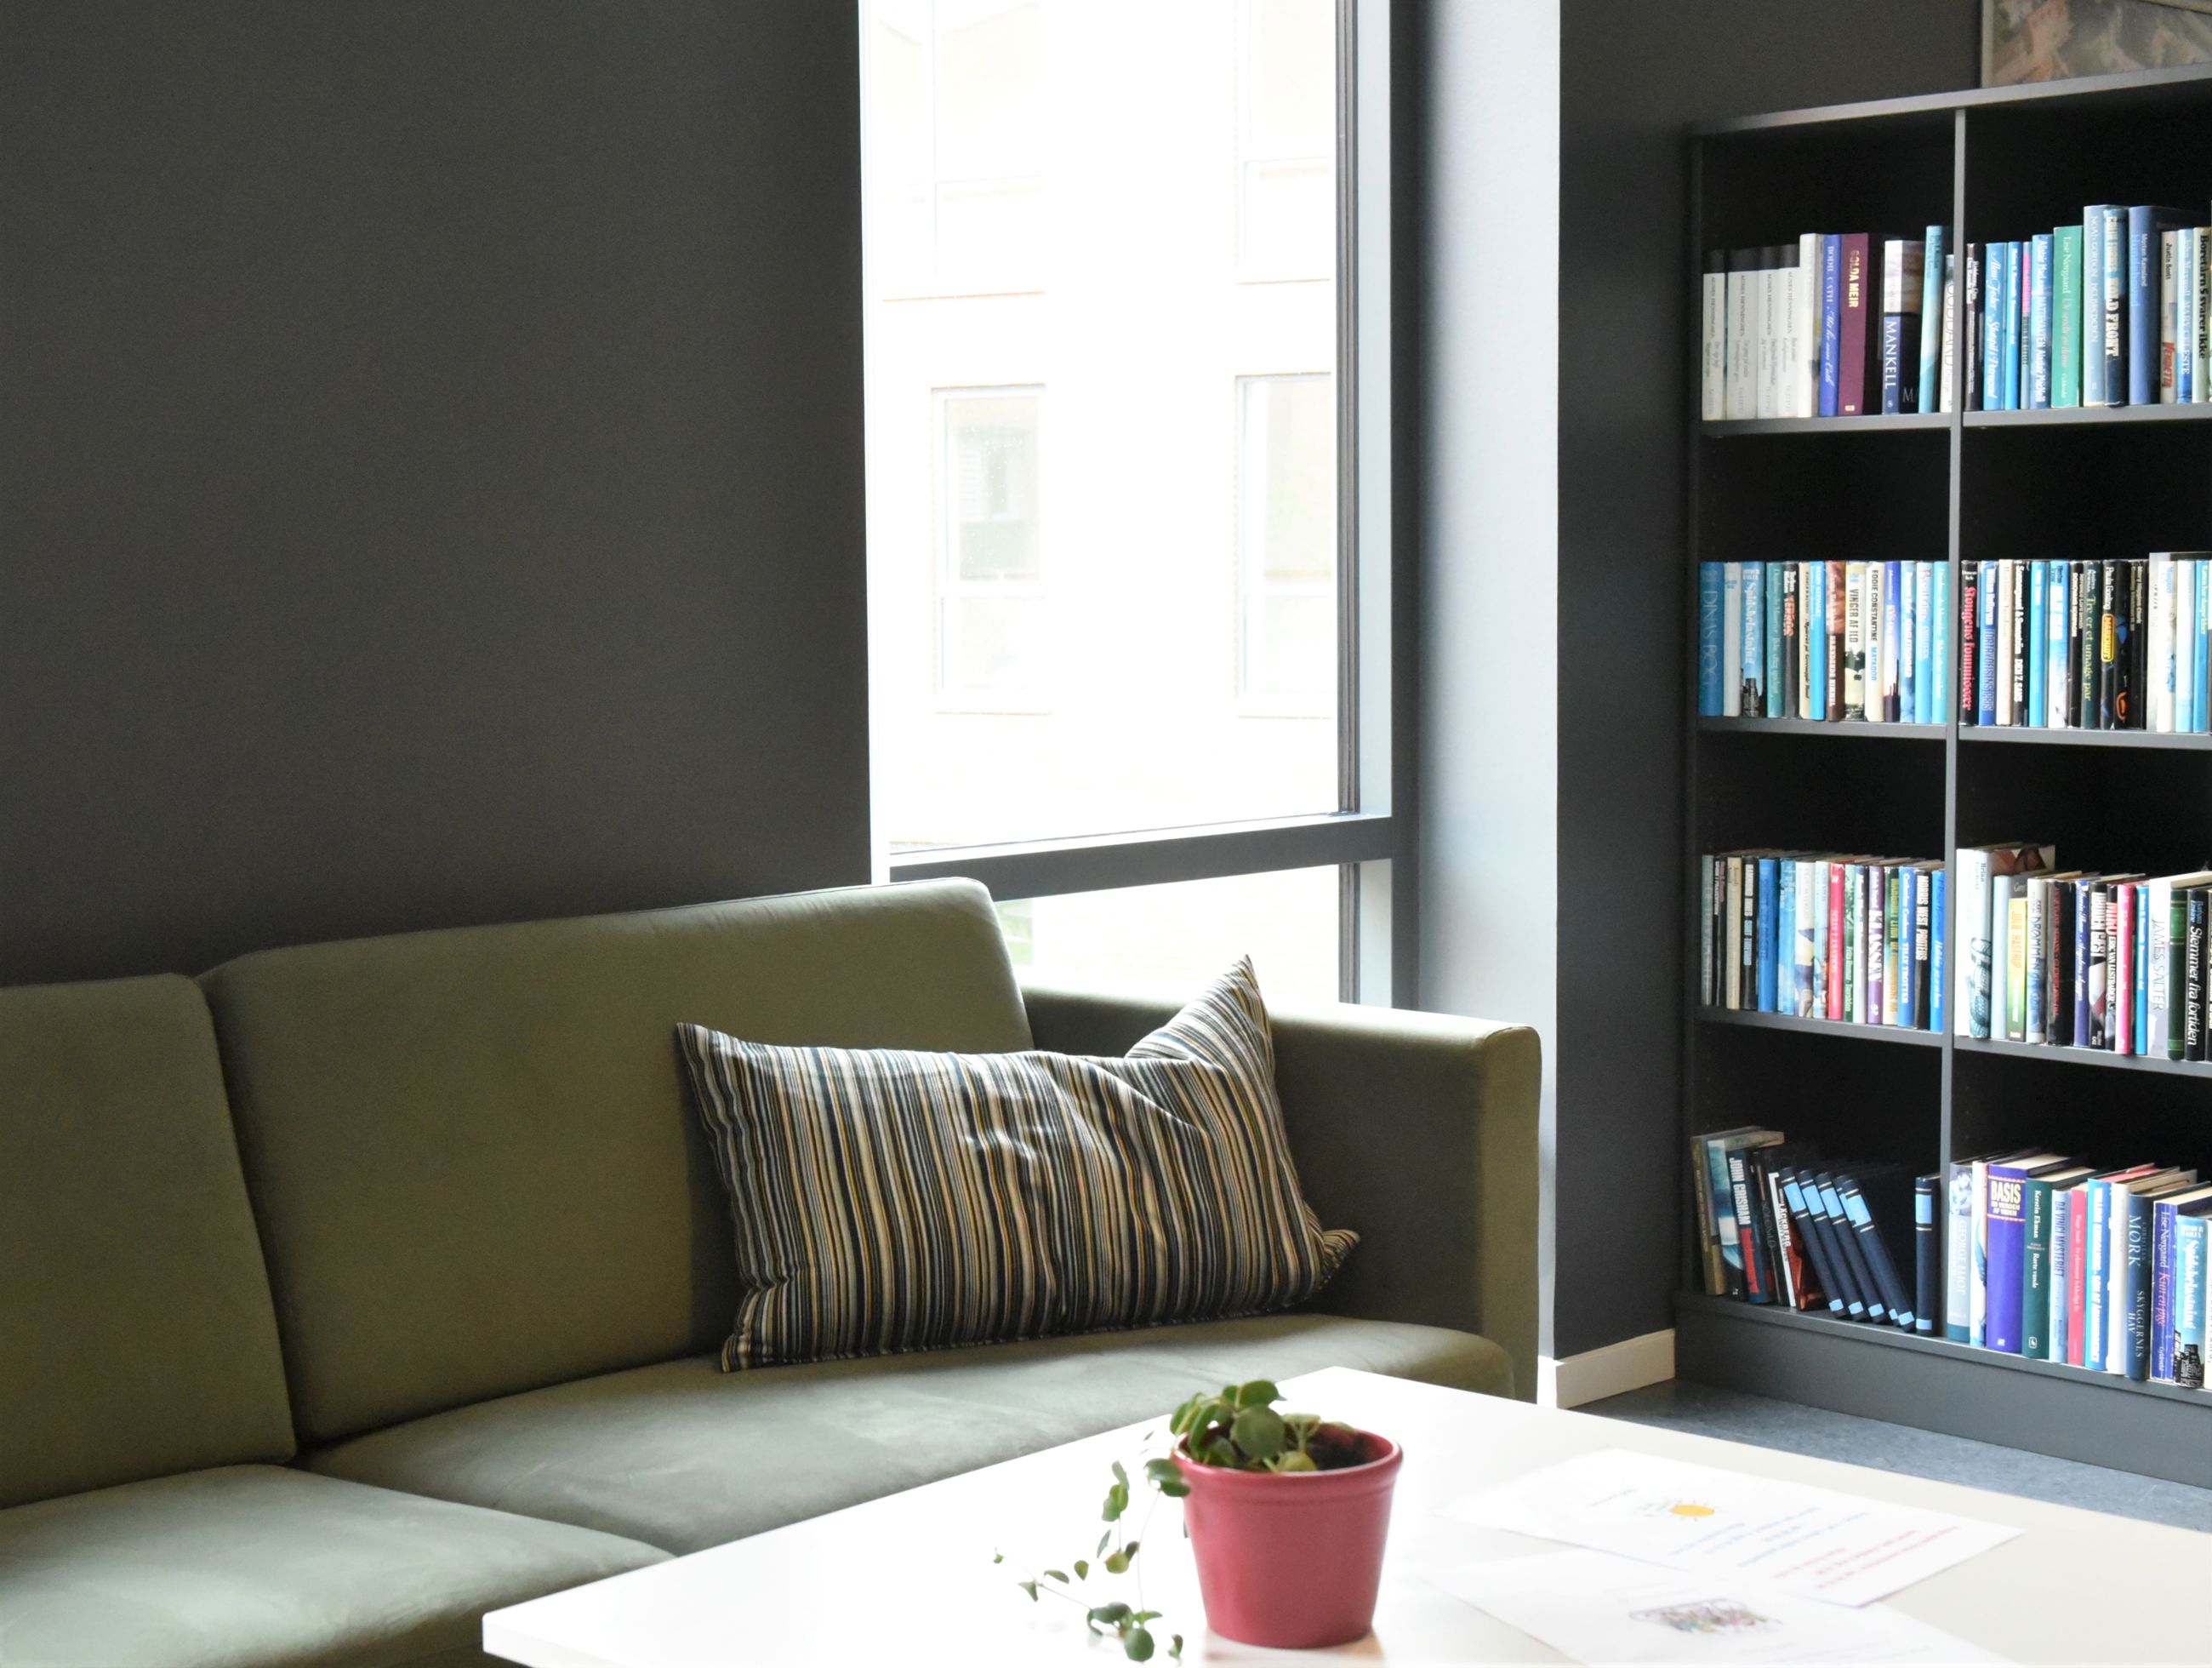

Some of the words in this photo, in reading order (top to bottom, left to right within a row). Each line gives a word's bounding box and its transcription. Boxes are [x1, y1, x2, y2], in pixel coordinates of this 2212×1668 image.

[2062, 237, 2072, 253] Lise
[1849, 250, 1860, 282] GOLDA
[2060, 253, 2071, 294] Nørgaard
[2198, 235, 2209, 287] Boretårn
[1849, 283, 1859, 308] MEIR
[2198, 296, 2206, 332] svarer
[2106, 313, 2118, 357] FRONT
[2198, 334, 2208, 359] ikke
[1885, 321, 1897, 390] MANKELL
[2105, 566, 2114, 586] Paula
[1849, 589, 1859, 618] VINGER
[1962, 586, 1976, 640] Kongens
[2086, 596, 2096, 614] Tre
[2103, 586, 2113, 610] Gosling
[1702, 590, 1718, 639] DINAS
[1849, 620, 1858, 629] AF
[2086, 617, 2094, 629] er
[1849, 630, 1858, 643] ILD
[2086, 631, 2094, 641] et
[1702, 645, 1718, 686] BOG
[2083, 644, 2093, 680] umage
[2083, 683, 2092, 702] par
[1916, 875, 1929, 905] MORRIS
[1916, 905, 1929, 926] WEST
[2090, 892, 2106, 929] UBUDEN
[2106, 902, 2118, 935] MIKO
[1867, 910, 1883, 983] KLASSEN
[1915, 928, 1928, 961] PROTEUS
[2010, 935, 2021, 968] HASTRUP
[2029, 917, 2042, 970] DRØMMEN
[2090, 931, 2106, 958] GÆST
[2108, 935, 2117, 953] ERIC
[2152, 920, 2165, 960] JAMES
[2189, 926, 2203, 979] Stemmer
[2108, 953, 2117, 963] VAN
[1901, 967, 1909, 1004] TROTTER
[2152, 965, 2165, 1011] SALTER
[2188, 982, 2202, 999] fra
[2187, 1001, 2201, 1046] fortiden
[1729, 1157, 1745, 1182] JOHN
[1733, 1183, 1751, 1225] GRISHAM
[1991, 1180, 2021, 1204] BASIS
[2033, 1190, 2042, 1214] Kerstin
[2055, 1201, 2066, 1214] DA
[2161, 1212, 2170, 1229] Lise
[2032, 1215, 2041, 1238] Ekman
[2054, 1214, 2066, 1234] VINCI
[1958, 1219, 1967, 1263] GEORGE
[2129, 1214, 2141, 1267] MØRK
[2160, 1229, 2169, 1268] Nørgaard
[2053, 1236, 2065, 1278] MYSTERIET
[1957, 1265, 1966, 1295] ELIOT
[2158, 1271, 2170, 1292] Kun
[2183, 1239, 2199, 1329] Spidsbelastning
[2128, 1312, 2136, 1334] HAV
[2135, 1290, 2145, 1357] SKYGGERNES
[2156, 1307, 2167, 1328] pige
